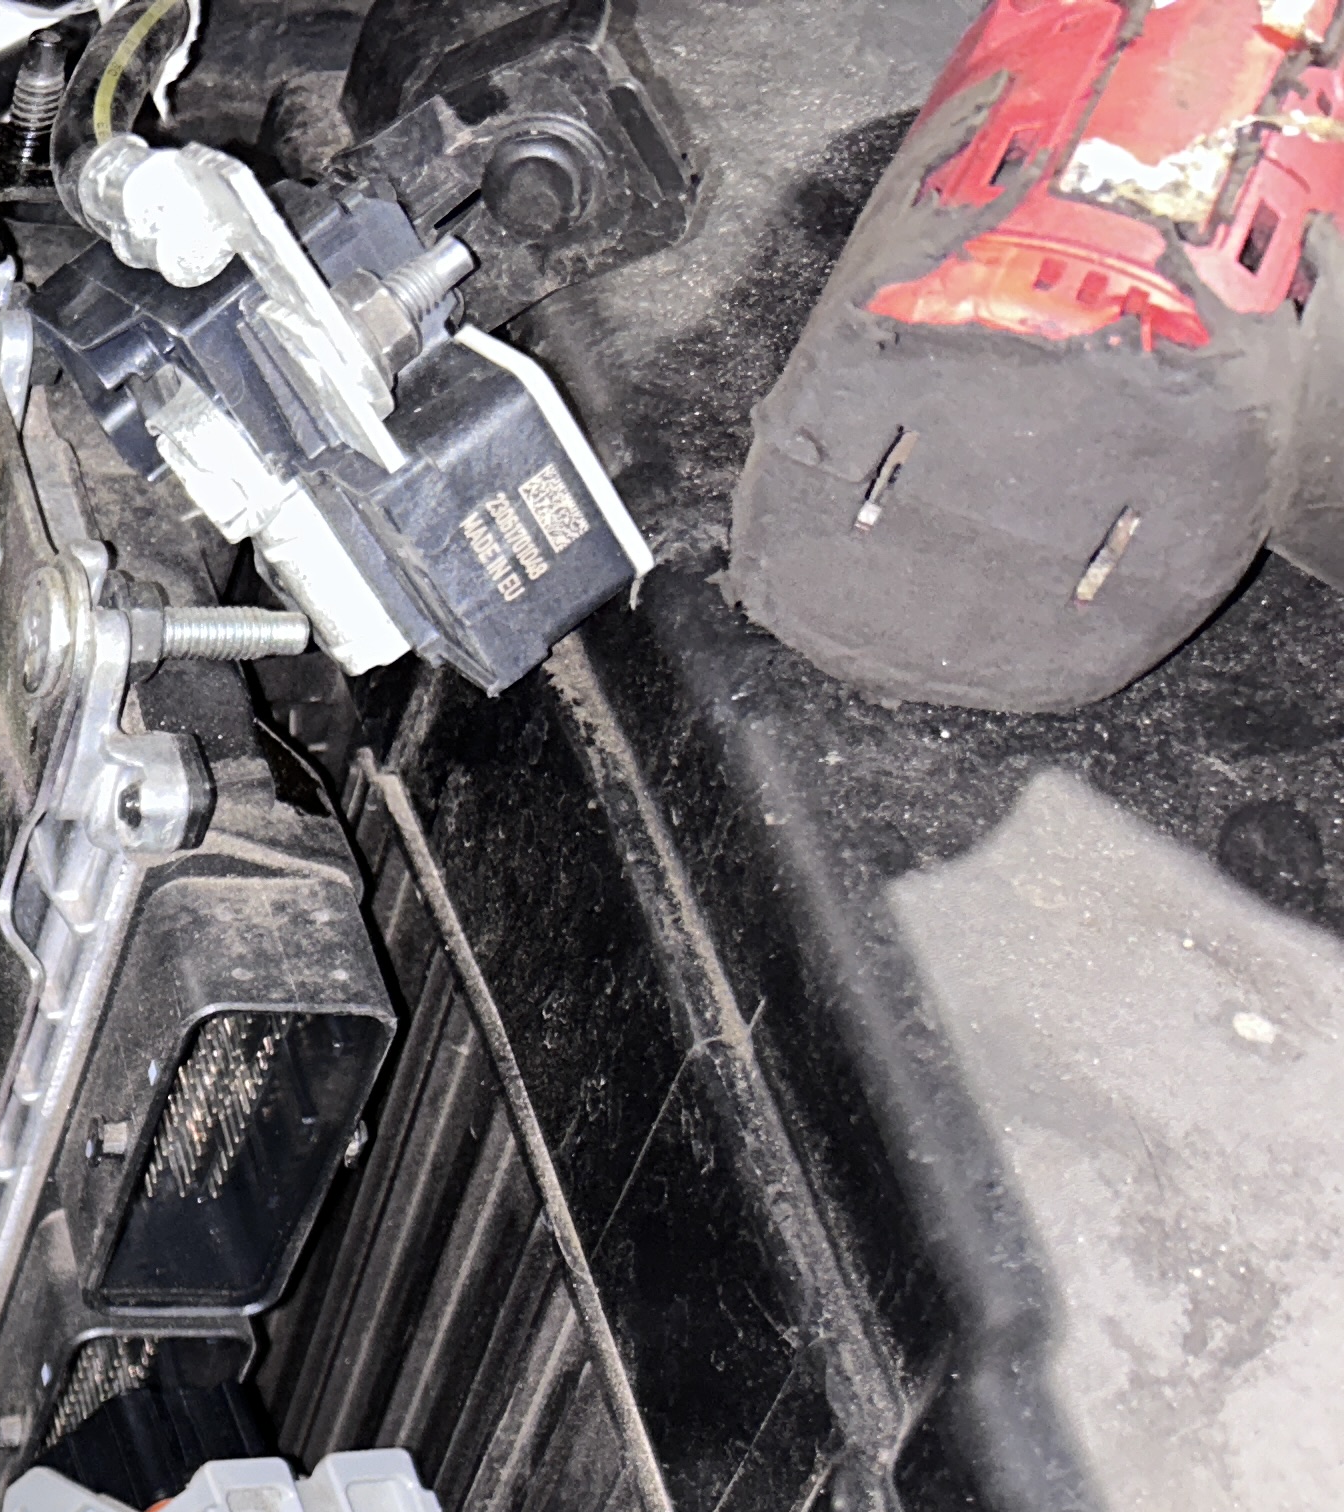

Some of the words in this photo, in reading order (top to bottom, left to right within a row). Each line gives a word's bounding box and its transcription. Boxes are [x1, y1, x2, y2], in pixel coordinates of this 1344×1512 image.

[459, 511, 501, 565] MADE
[486, 554, 513, 582] IN
[498, 571, 526, 602] EU
